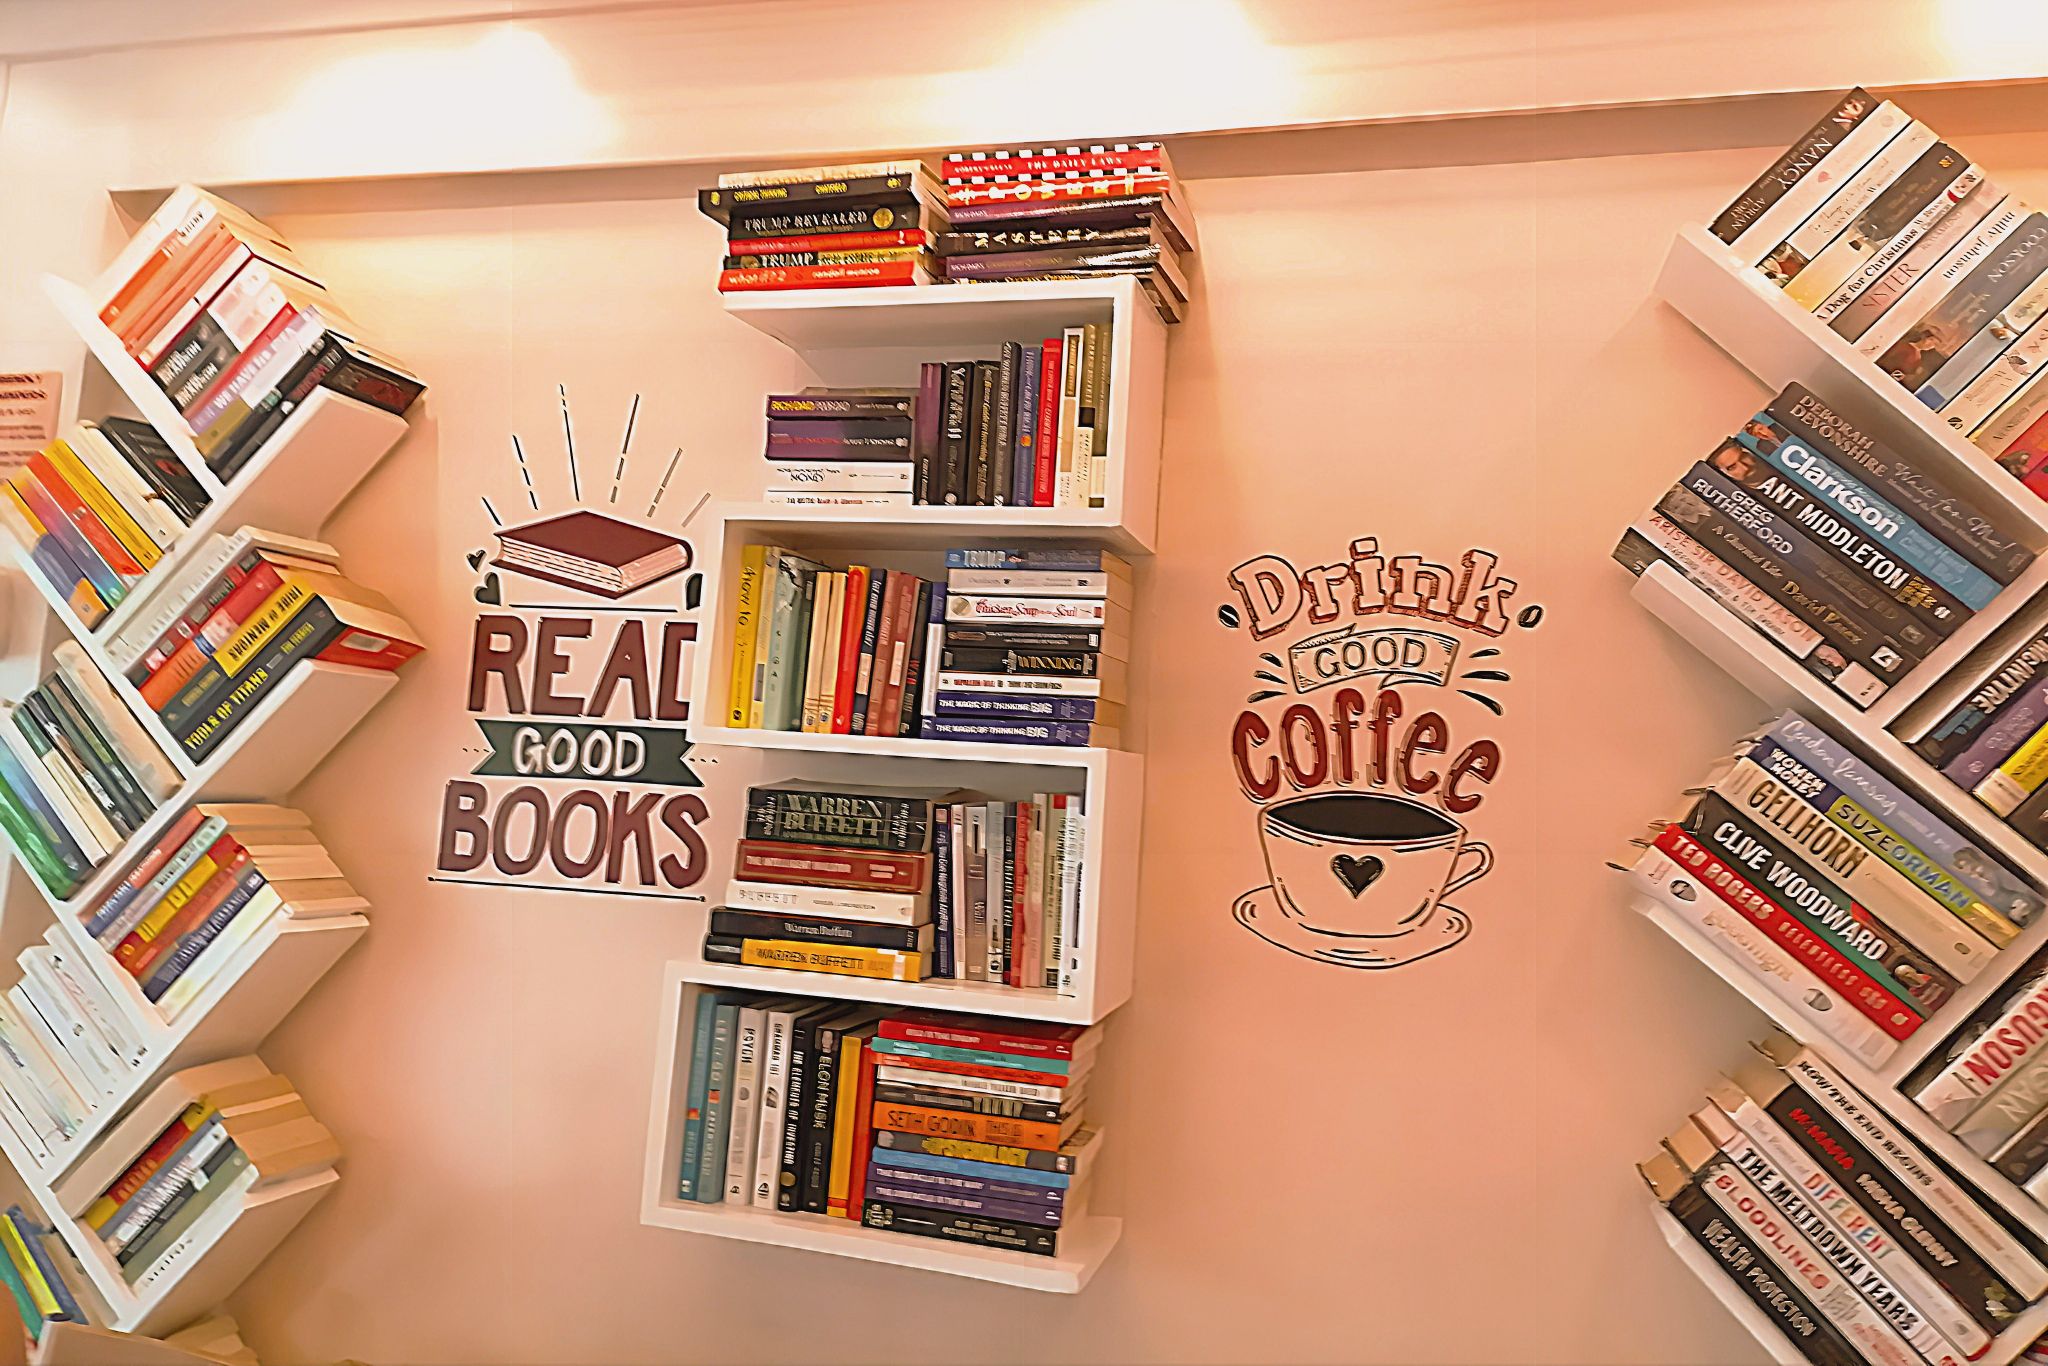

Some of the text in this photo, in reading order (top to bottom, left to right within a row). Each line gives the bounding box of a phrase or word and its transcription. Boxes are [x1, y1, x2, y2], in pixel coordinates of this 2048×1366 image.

[1776, 138, 1833, 189] NANCY
[975, 228, 1100, 248] MASTERY
[1732, 198, 1766, 230] ADRIAN
[760, 252, 814, 267] TRUMP
[1824, 289, 1851, 315] Dog
[1846, 274, 1866, 293] for
[1863, 226, 1918, 277] Christmas
[1939, 209, 2016, 280] milly johnson
[1861, 259, 1918, 312] SISTER
[214, 388, 235, 409] WE
[1802, 395, 1871, 449] DEBORAH
[1792, 405, 1884, 476] DEVONSHIRE
[1695, 478, 1791, 556] RUTHERFORD
[1731, 488, 1773, 525] GREG
[1781, 443, 1900, 538] Clarkson
[1756, 472, 1906, 591] ANT MIDDLETON
[1227, 537, 1518, 641] Drink
[1650, 513, 1814, 642] ARISE SIR DAVID JASON
[1781, 579, 1825, 618] David
[1017, 655, 1082, 670] WINNING
[1314, 637, 1426, 678] GOOD
[185, 667, 269, 750] TOOLS OF TITANS
[939, 699, 955, 707] THE
[956, 700, 980, 708] MAGIC
[993, 702, 1029, 711] THINKING
[1030, 702, 1053, 714] BIG
[952, 724, 976, 733] MAGIC
[989, 726, 1025, 735] THINKING
[1025, 726, 1049, 738] BIG
[511, 727, 646, 778] GOOD
[1771, 748, 1824, 792] WOMEN
[786, 794, 883, 817] WARREN
[1770, 761, 1818, 801] MONEY
[437, 779, 710, 889] BOOKS
[783, 811, 882, 837] BUFFETT
[1746, 780, 1870, 880] GELLHORN
[1670, 834, 1773, 921] TED ROGERS
[1837, 803, 1895, 852] SUZE
[1891, 844, 1969, 908] ORMAN
[738, 889, 798, 904] BUFFETT
[1713, 818, 1885, 963] CLIVE WOODWARD
[783, 922, 819, 934] Warren
[755, 947, 864, 969] WARREN BUFFETT
[811, 1055, 832, 1129] ELON MUSK
[1797, 1059, 1933, 1188] HOW THE END BEGINS
[1803, 1173, 1895, 1261] DIFFERENT
[1855, 1172, 1906, 1220] MISHA
[1716, 1173, 1827, 1290] BLOODLINES
[1736, 1145, 1778, 1187] THE
[1772, 1181, 1861, 1276] MELTDOWN
[1858, 1270, 1918, 1333] YEARS
[1701, 1218, 1816, 1337] WEALTH PROTECTION
